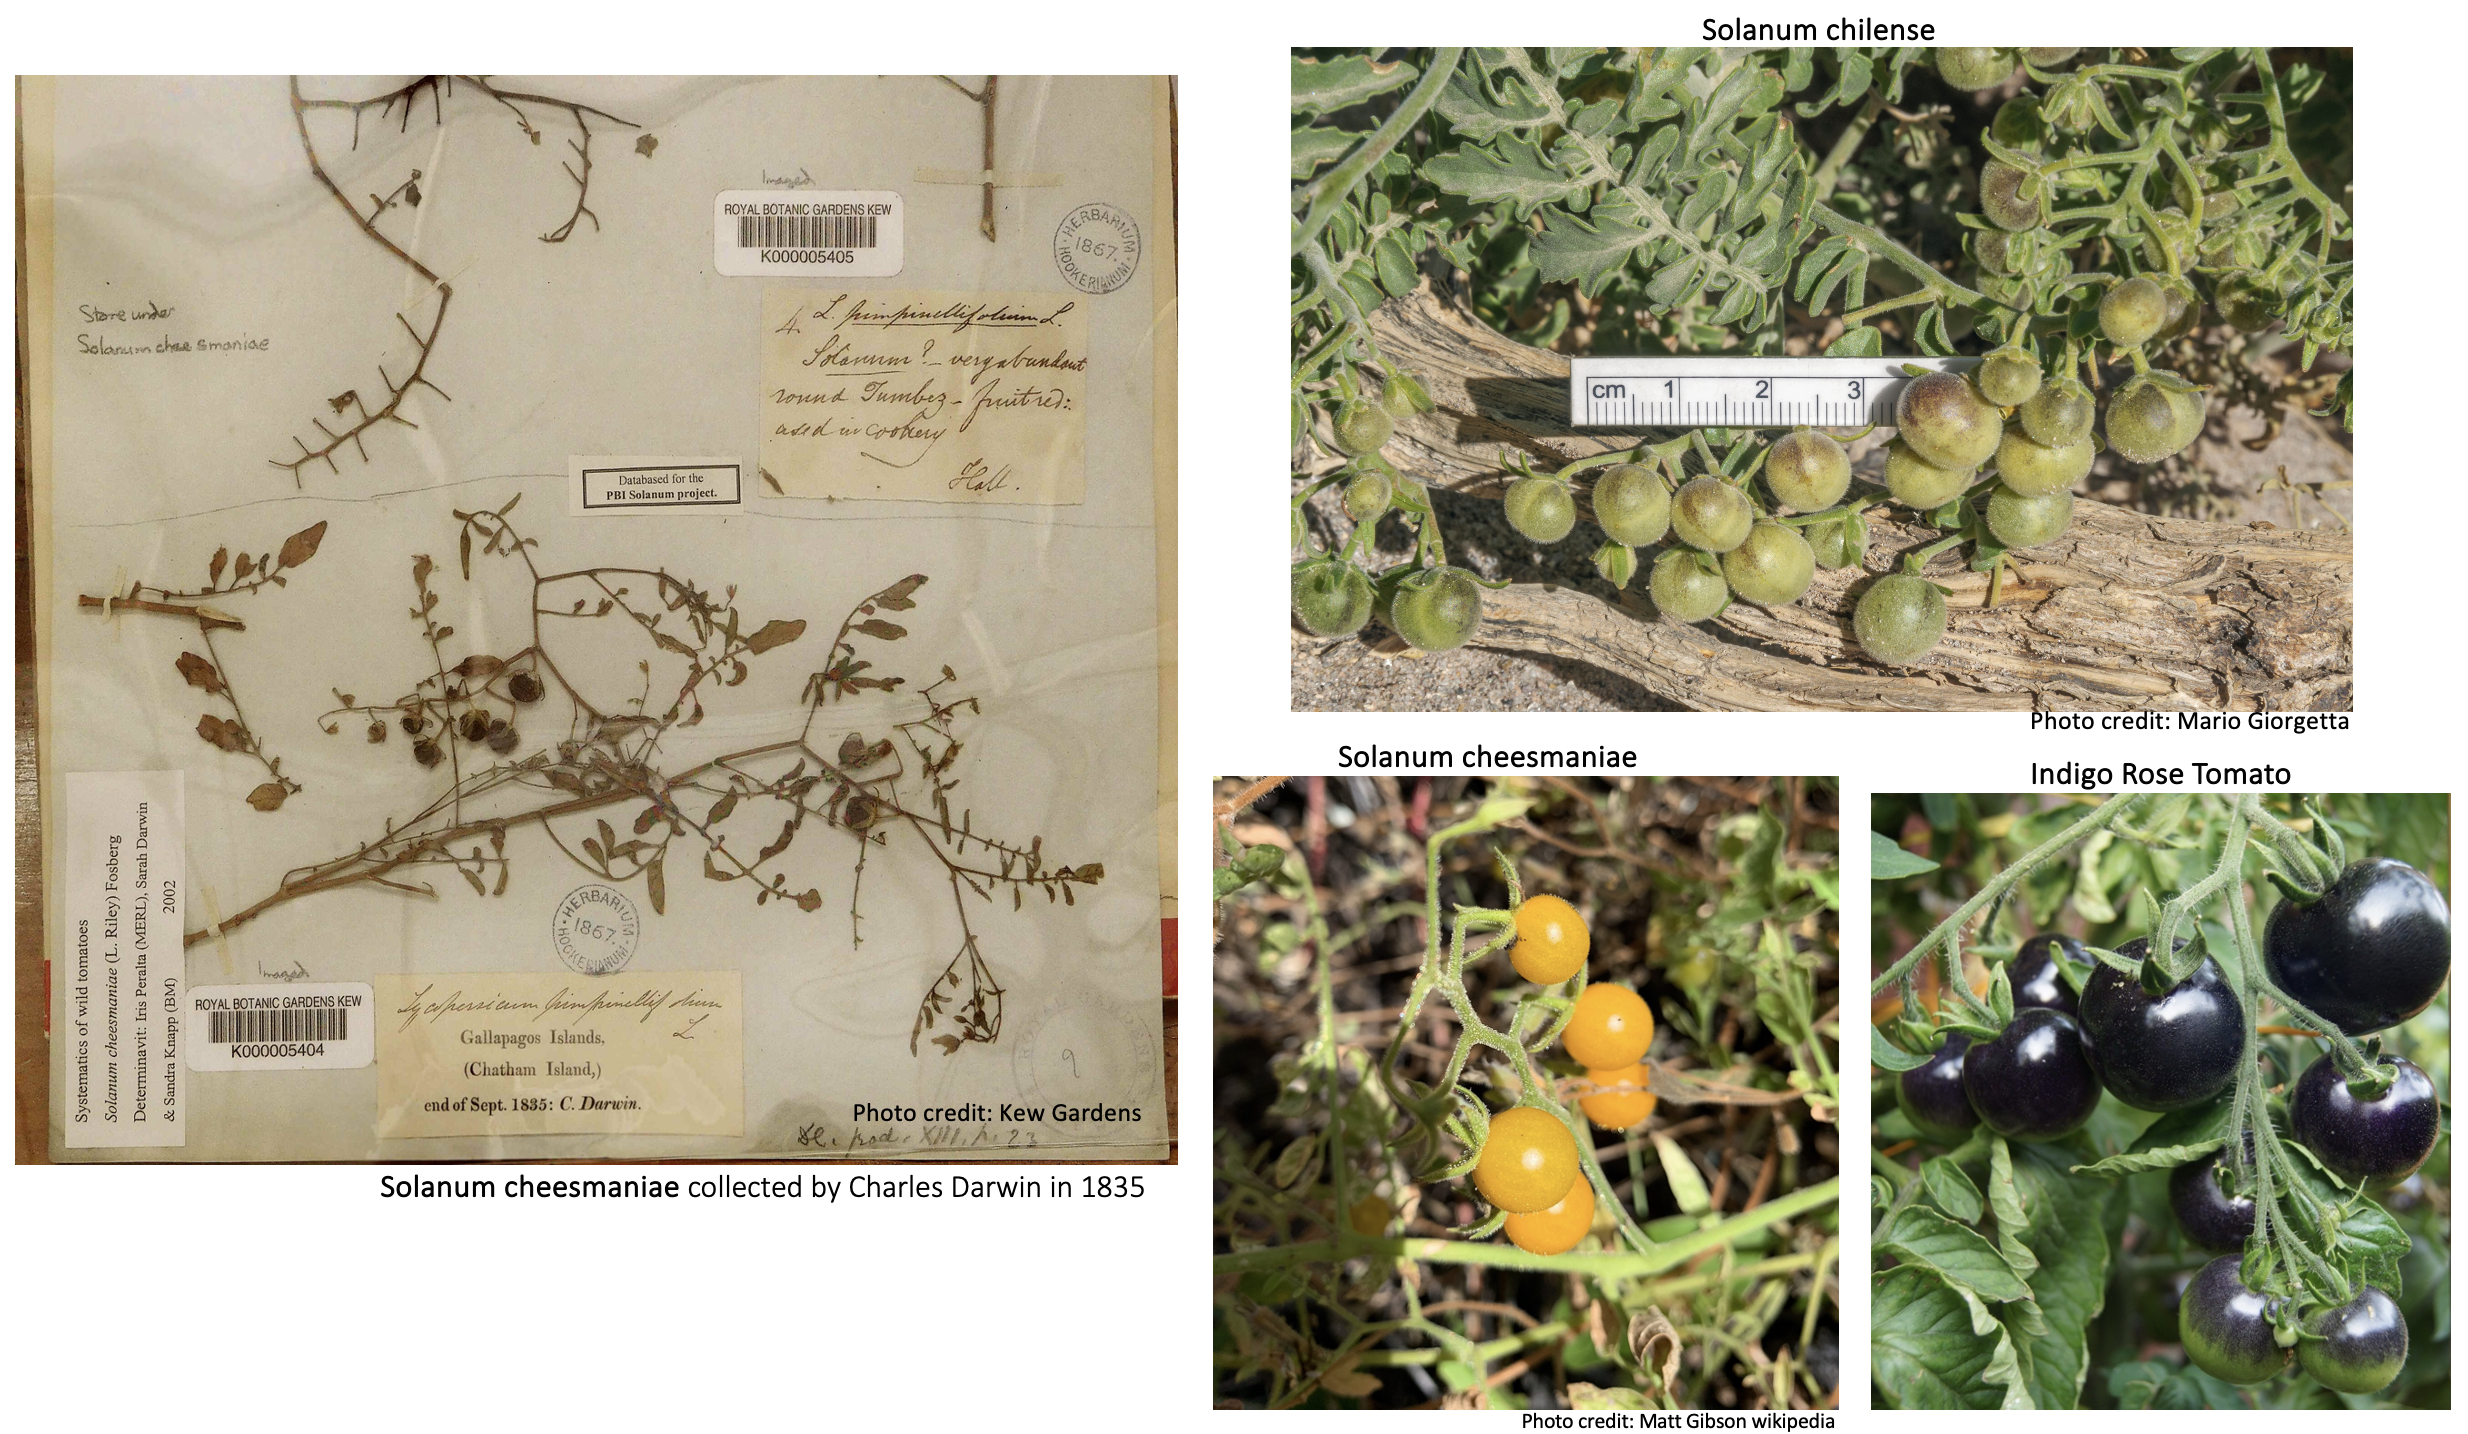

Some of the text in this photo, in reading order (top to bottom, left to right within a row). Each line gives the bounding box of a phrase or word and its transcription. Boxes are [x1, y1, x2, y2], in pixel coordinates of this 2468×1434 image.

[762, 167, 816, 189] Imaged
[724, 203, 892, 216] ROYAL BOTANIC GARDENS KEW
[1062, 208, 1136, 253] HERBARIUM
[761, 250, 854, 264] K000005405
[1058, 246, 1131, 291] HOOKERIANUM
[79, 300, 175, 323] Store under
[77, 334, 151, 356] Solanum
[802, 333, 913, 369] Solanum
[770, 387, 849, 405] round
[1592, 380, 1861, 399] cm 1 2 3
[618, 473, 704, 486] Databased for the
[606, 488, 718, 502] PBI Solanum project.
[562, 889, 635, 936] HERBARIUM
[557, 927, 629, 973] HOOKERIANUM
[133, 801, 150, 1123] Determinavit: Iris Peralta (MERL), Sarah Darwin
[258, 960, 310, 982] Imaged
[104, 834, 122, 1123] Solanum cheesmaniae (L. Riley) Fosberg
[162, 880, 179, 1122] & Sandra Knapp (BM) 2002
[195, 995, 362, 1011] ROYAL BOTANIC GARDENS KEW
[74, 919, 90, 1123] Systematics of wild tomatoes
[460, 1029, 605, 1049] Gallapagos Islands,
[231, 1044, 325, 1059] K000005404
[463, 1061, 602, 1080] (Chatham Island,)
[424, 1096, 642, 1116] end of Sept. 1835: C. Darwin.
